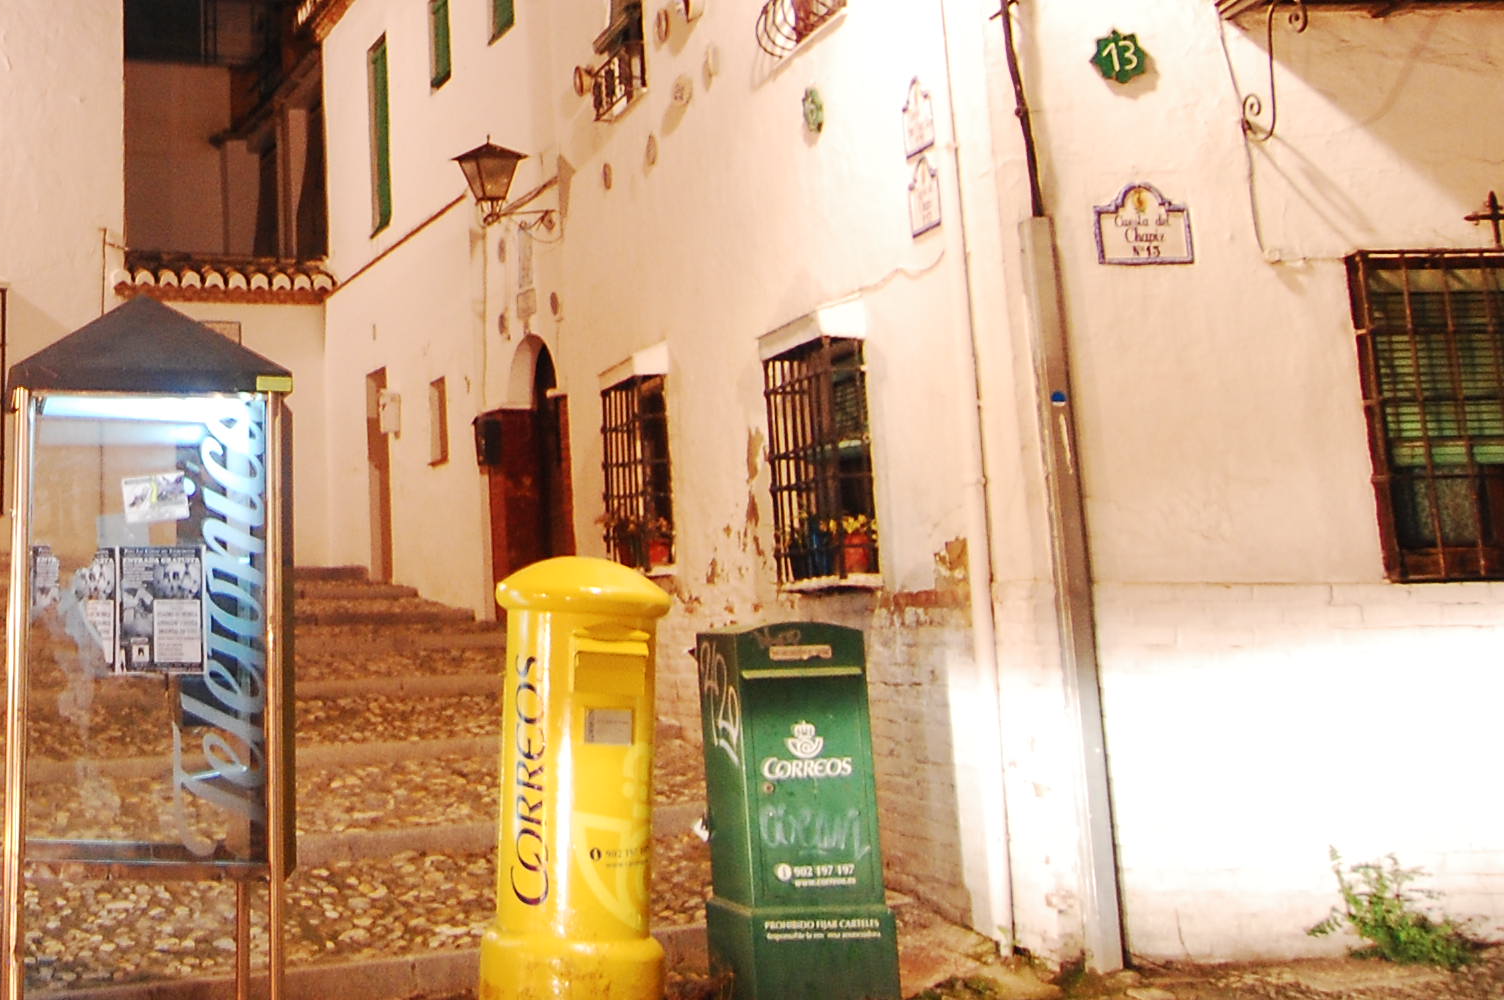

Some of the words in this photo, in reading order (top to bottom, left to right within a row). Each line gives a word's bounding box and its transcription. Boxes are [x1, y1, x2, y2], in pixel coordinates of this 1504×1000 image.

[1102, 41, 1138, 72] 13
[762, 756, 853, 780] CORREOS
[510, 655, 549, 906] CORREOS
[793, 865, 813, 878] 902
[816, 864, 834, 877] 197
[837, 863, 855, 876] 197
[764, 919, 815, 930] PROHIBIDO
[816, 919, 838, 930] FIJAR
[839, 917, 880, 929] CARTELES
